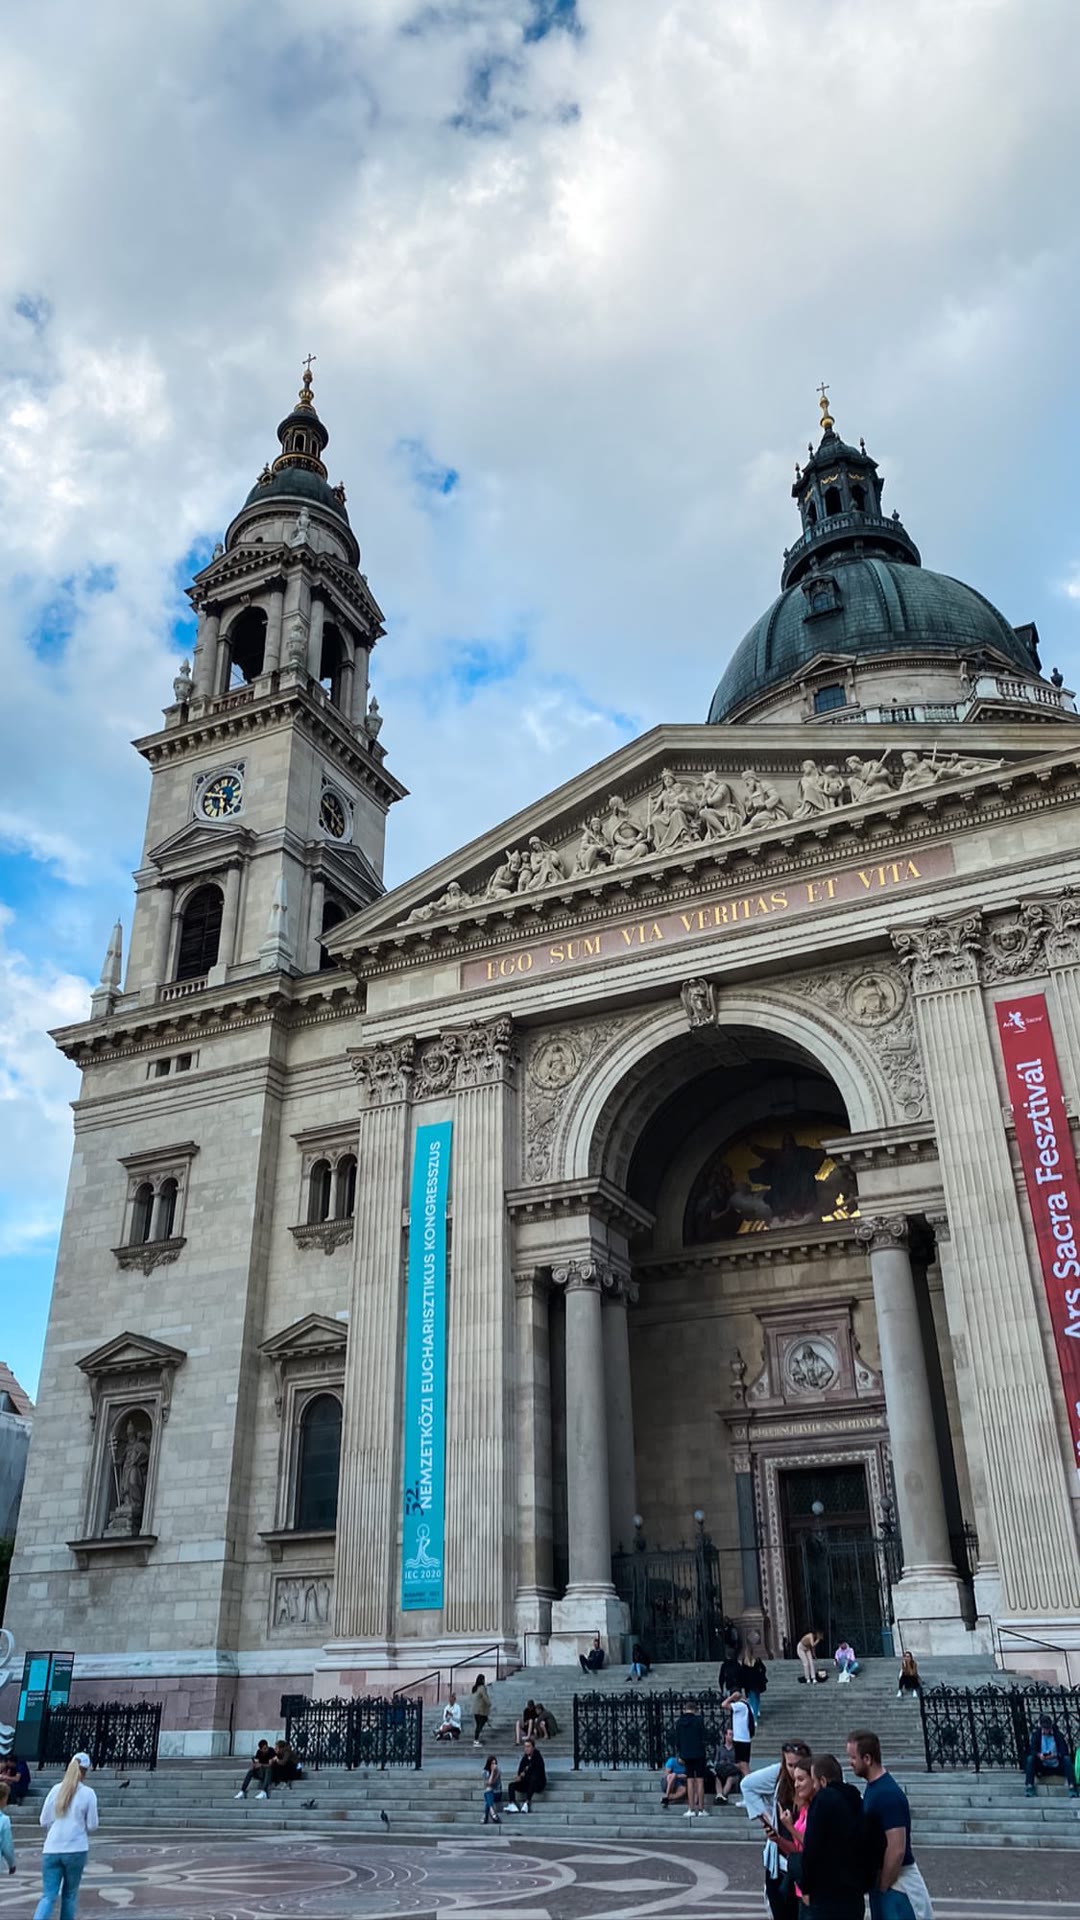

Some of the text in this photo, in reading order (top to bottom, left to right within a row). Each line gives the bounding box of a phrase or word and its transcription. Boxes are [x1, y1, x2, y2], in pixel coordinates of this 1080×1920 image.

[486, 860, 922, 980] EGO SUM VIA VERITAS ET VITA
[1016, 1058, 1063, 1185] Fesztivál
[1048, 1191, 1080, 1280] Sacra
[418, 1140, 441, 1509] NEMZETKÖZI EUCHARISZTIKUS KONGRESSZUS
[405, 1480, 424, 1517] 52.
[404, 1569, 441, 1580] IEC 2020
